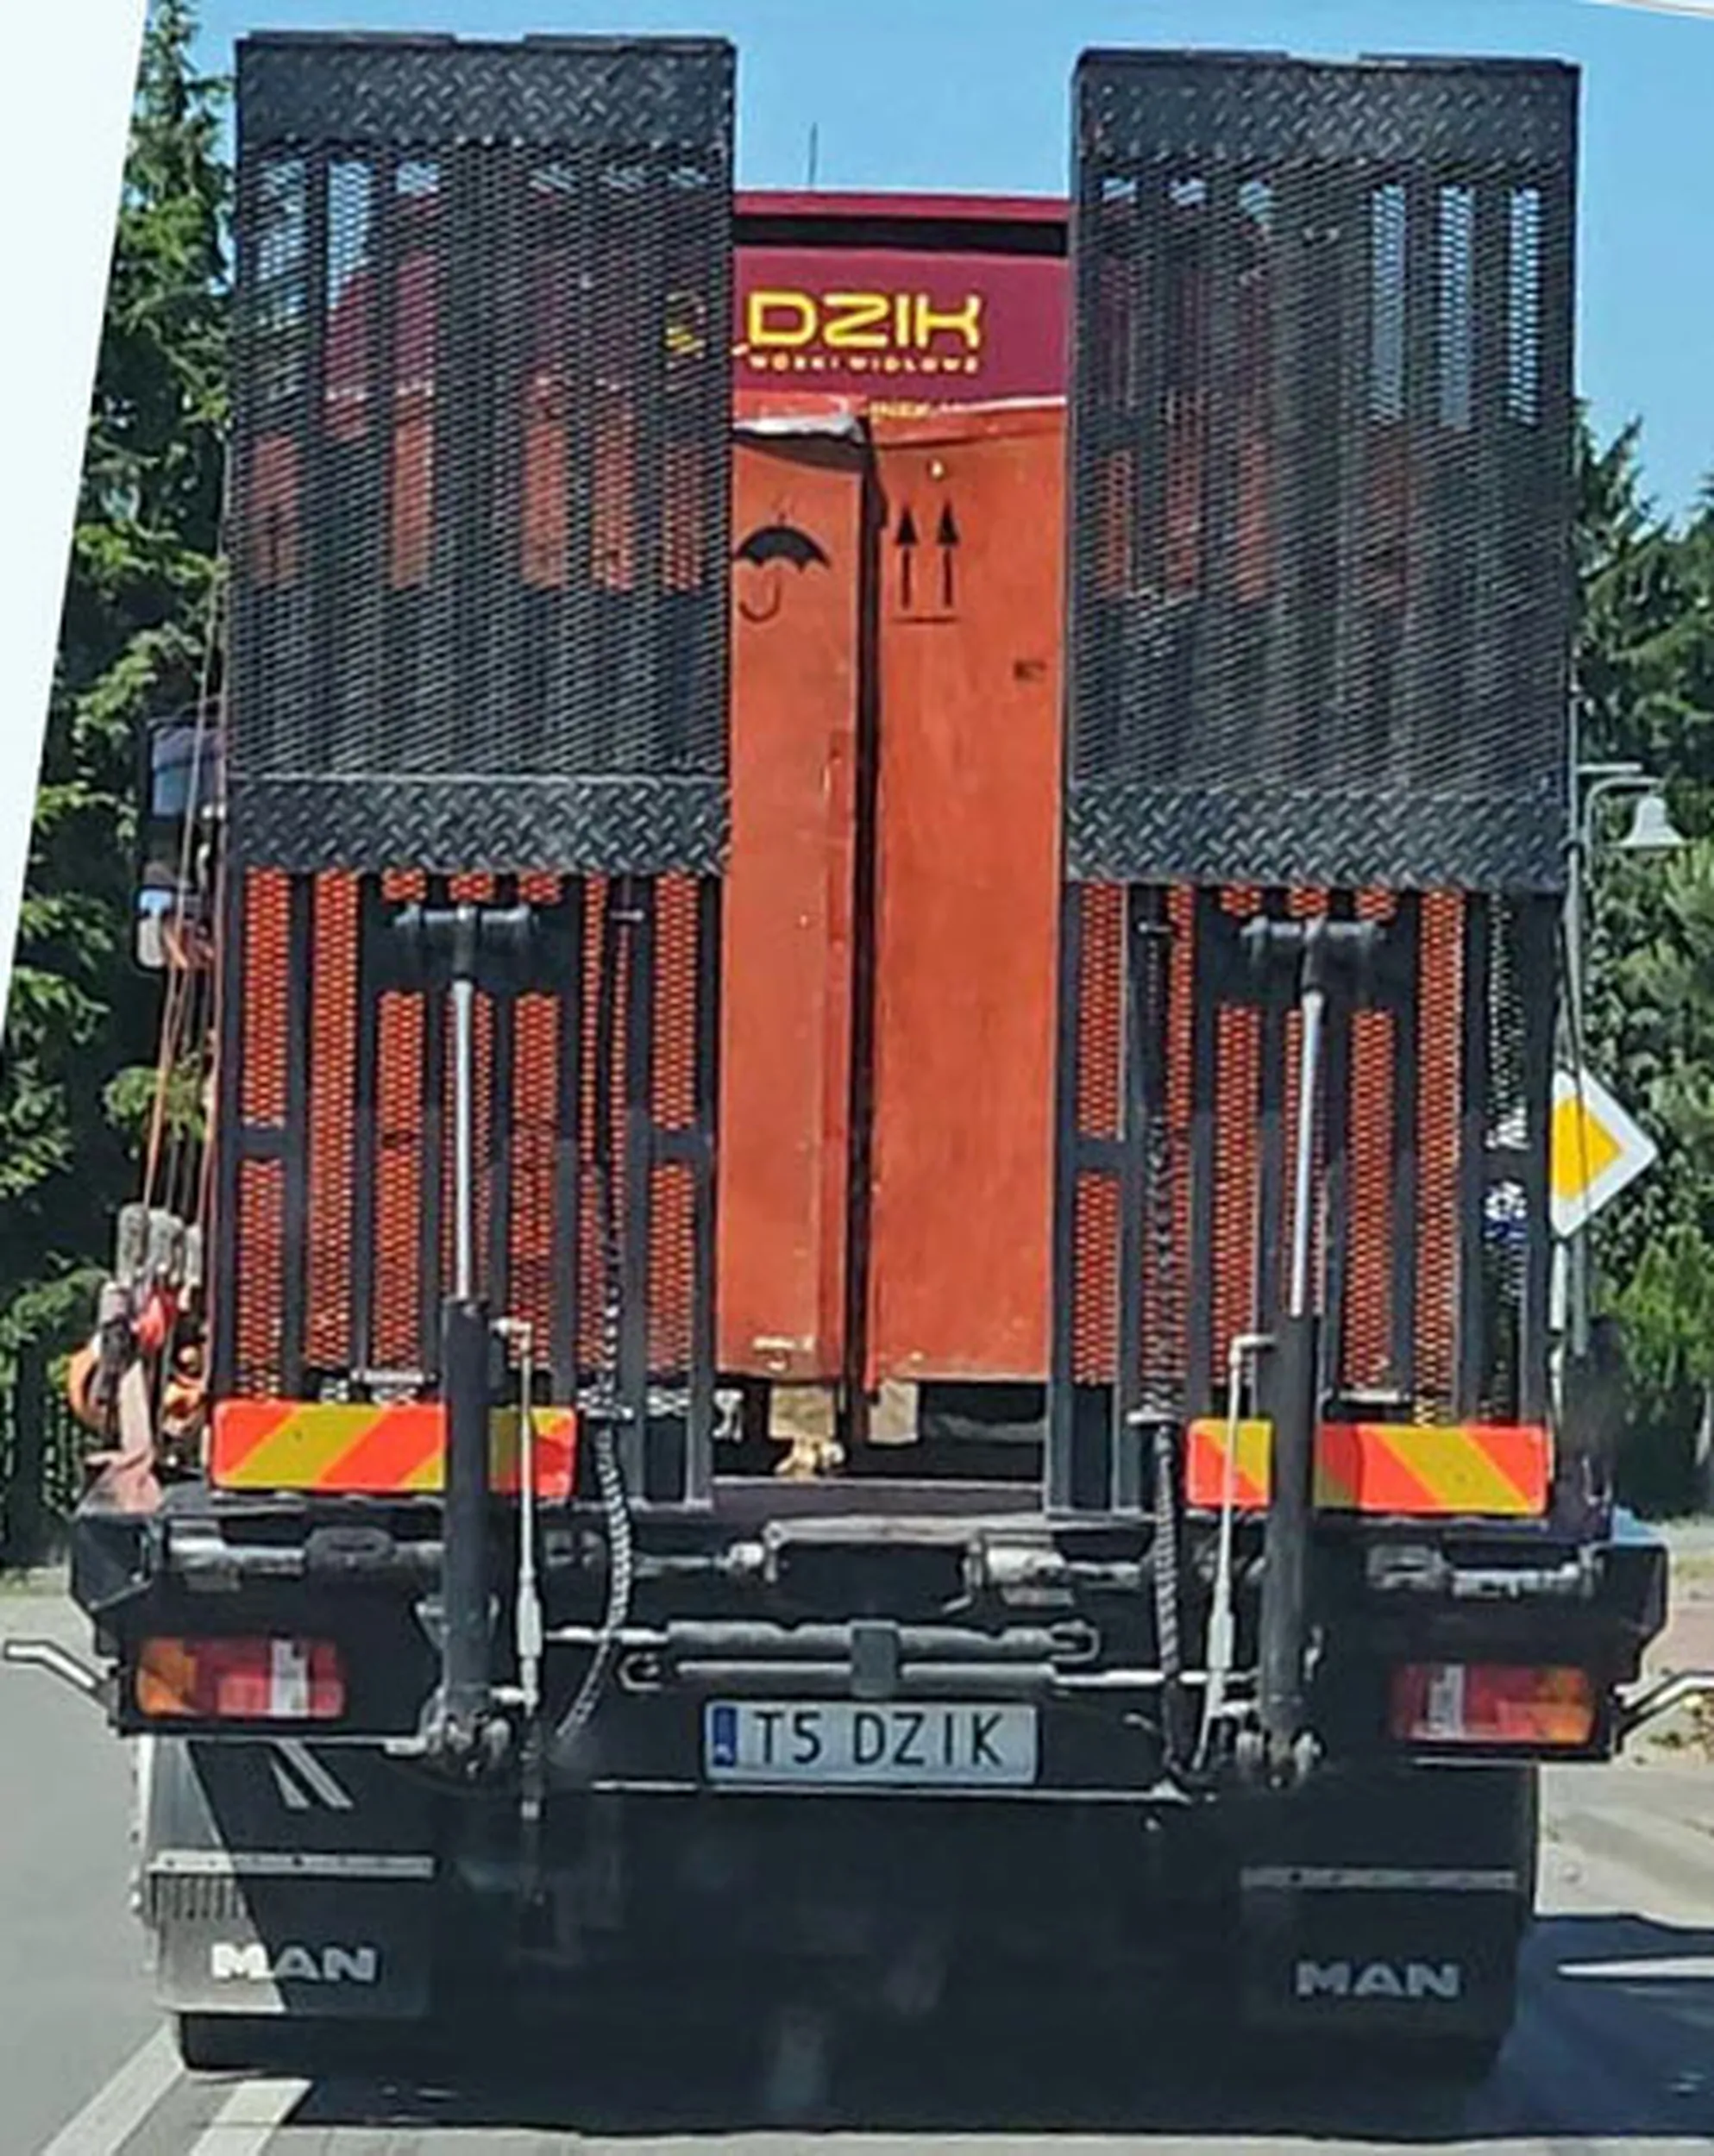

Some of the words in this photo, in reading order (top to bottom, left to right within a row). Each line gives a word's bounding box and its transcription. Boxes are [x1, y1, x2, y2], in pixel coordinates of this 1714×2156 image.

[748, 291, 981, 348] DZIK
[753, 1710, 821, 1764] T5
[852, 1711, 1003, 1765] DZIK
[211, 1943, 377, 1981] MAN
[1296, 1961, 1460, 1996] MAN
